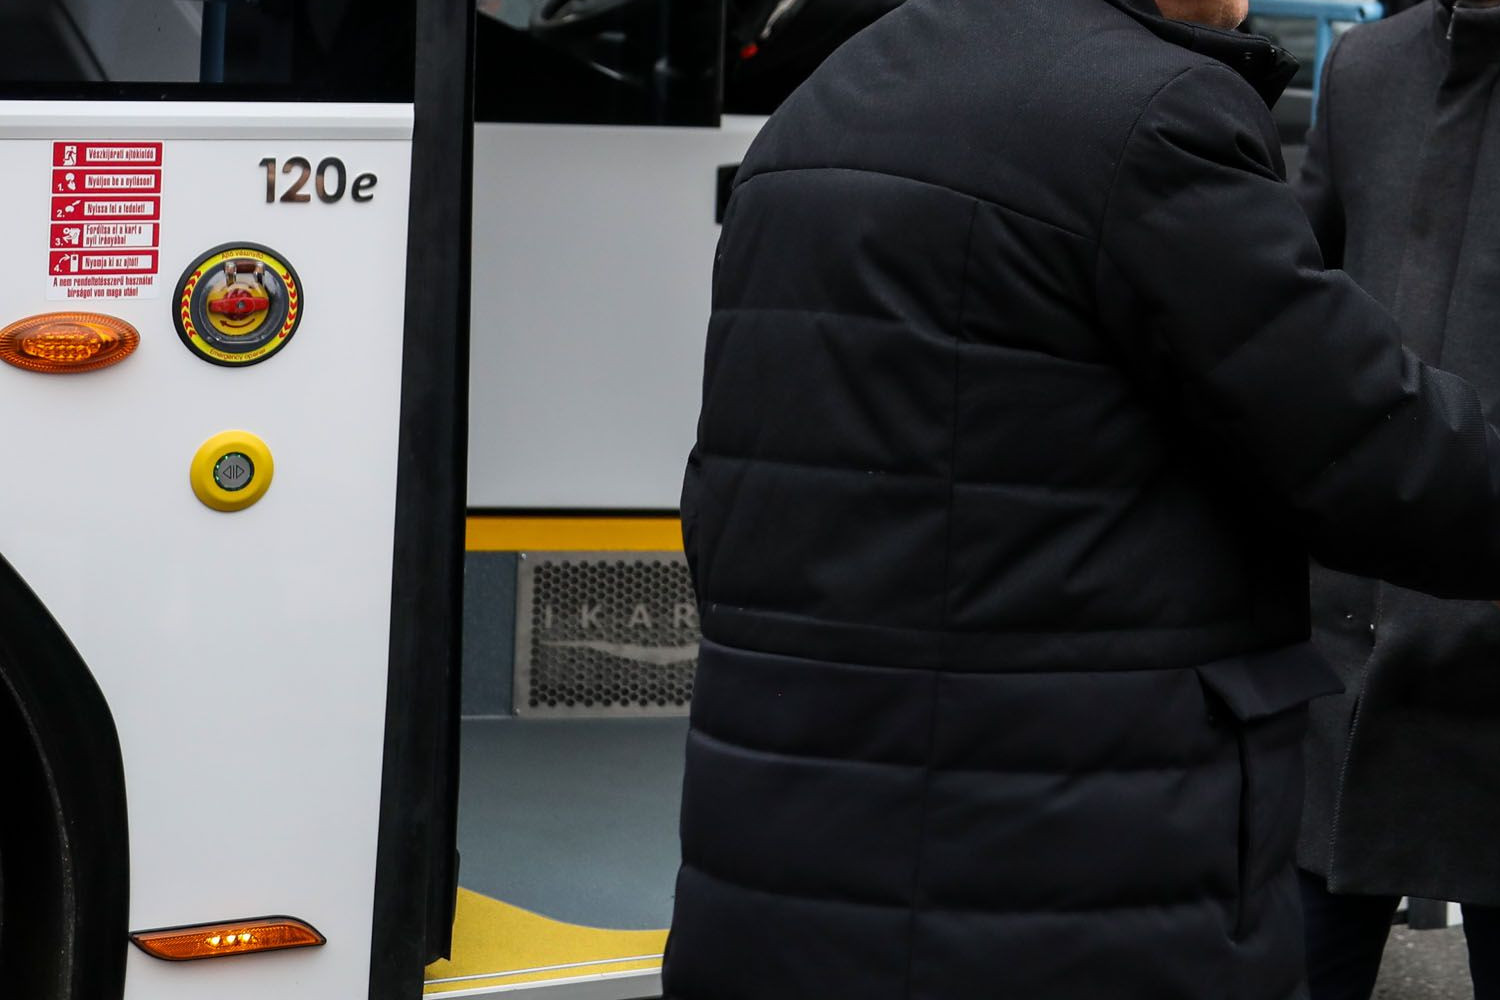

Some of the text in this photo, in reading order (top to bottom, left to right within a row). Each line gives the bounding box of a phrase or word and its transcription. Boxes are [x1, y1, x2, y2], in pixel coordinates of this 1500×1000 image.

[55, 238, 64, 246] 3.
[125, 224, 137, 234] kart
[53, 264, 63, 273] 4.
[59, 278, 72, 287] nem
[106, 289, 122, 298] maga
